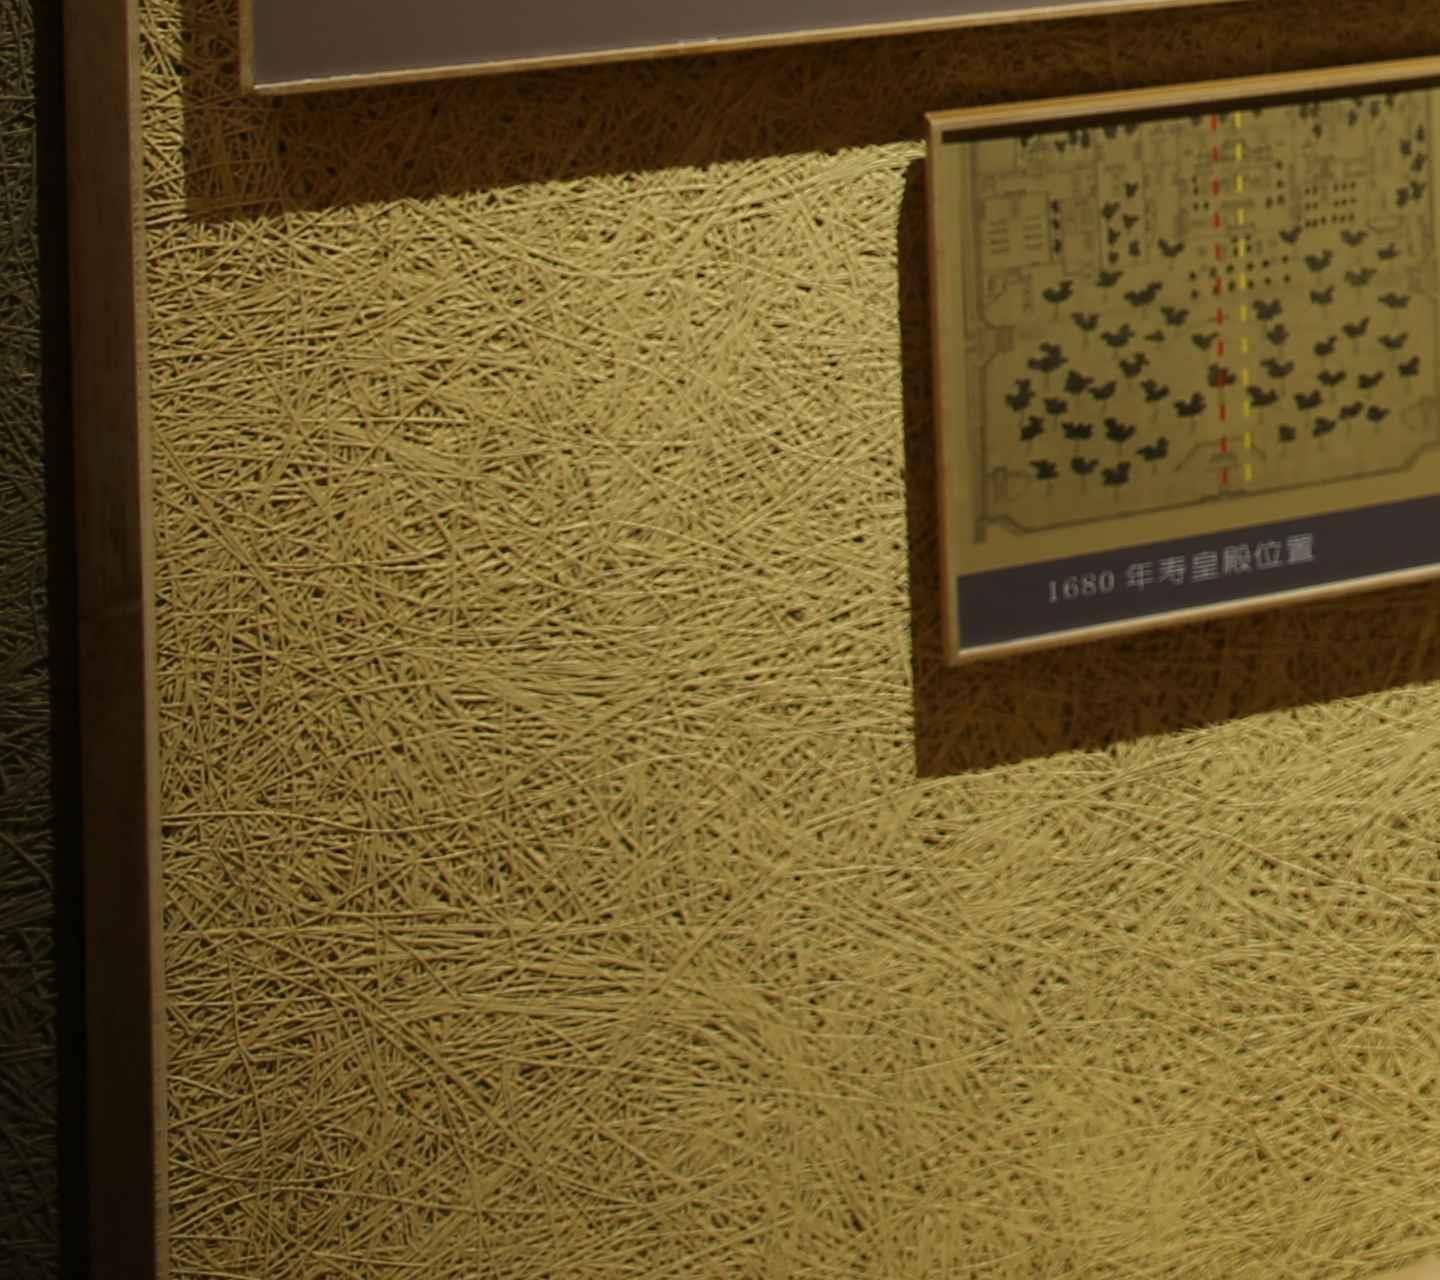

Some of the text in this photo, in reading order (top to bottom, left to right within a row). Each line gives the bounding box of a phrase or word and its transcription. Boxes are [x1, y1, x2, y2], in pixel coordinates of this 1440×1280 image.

[1045, 532, 1316, 604] 1680 年寿皇殿位置
